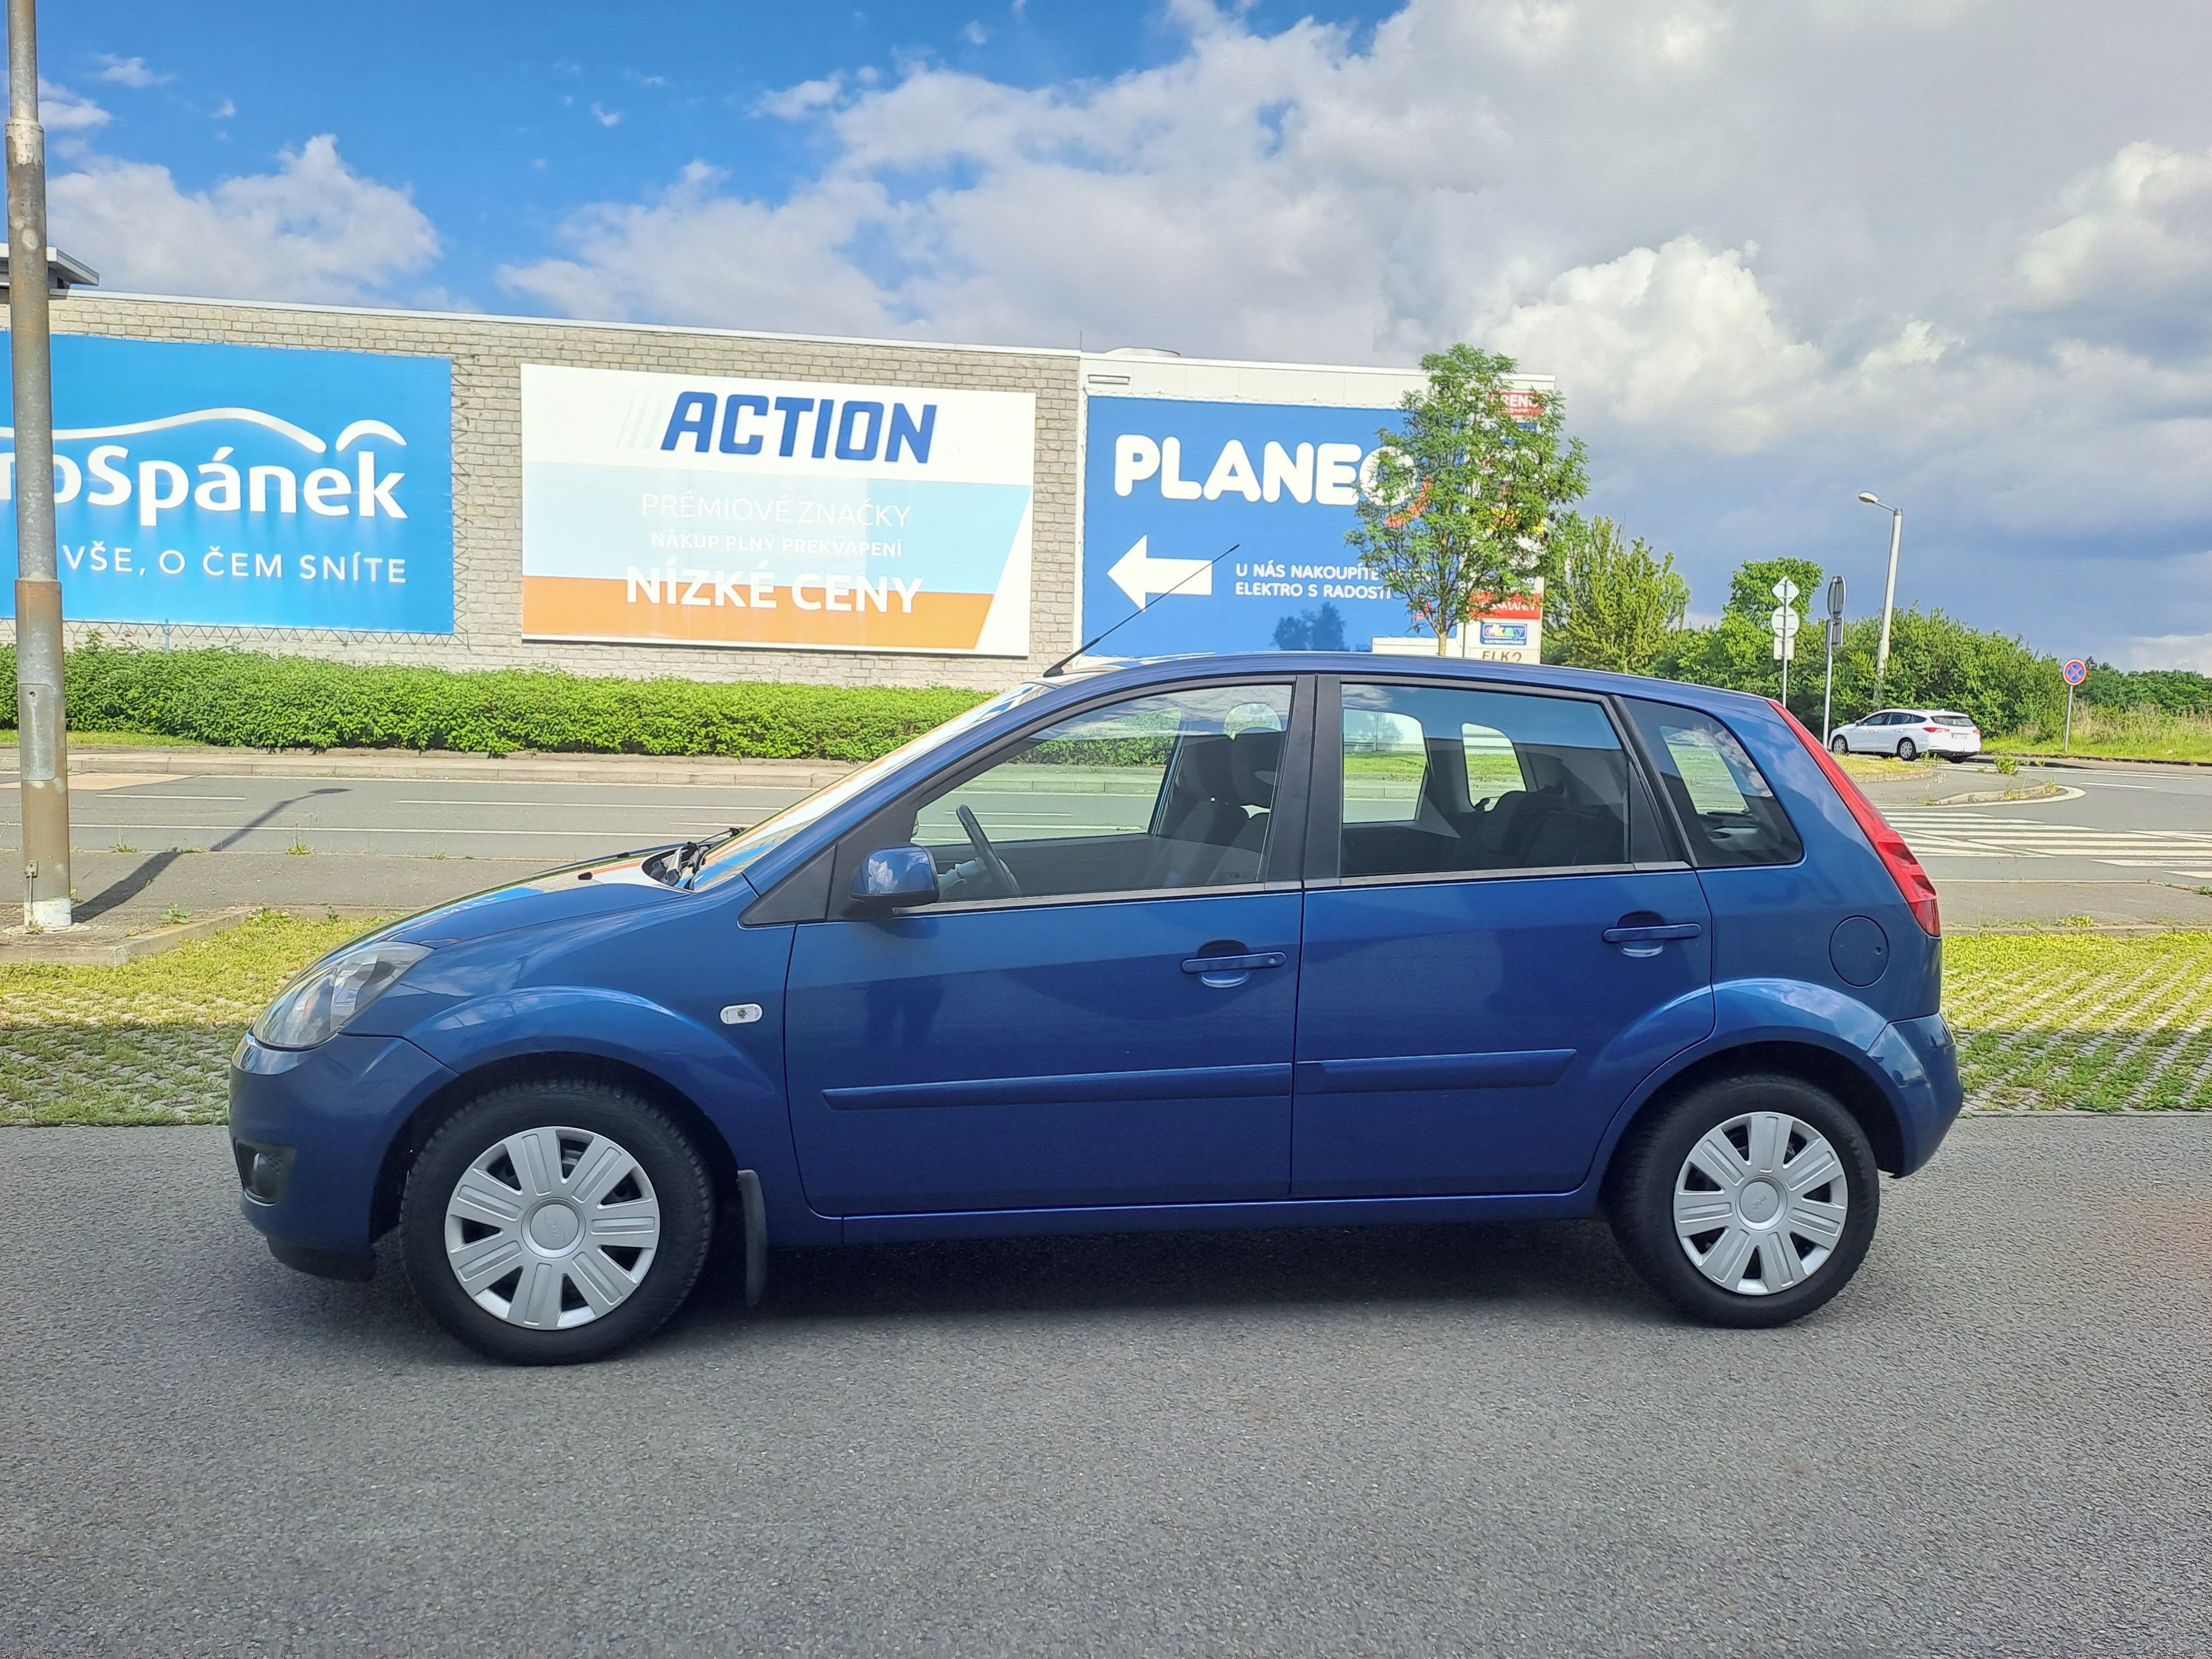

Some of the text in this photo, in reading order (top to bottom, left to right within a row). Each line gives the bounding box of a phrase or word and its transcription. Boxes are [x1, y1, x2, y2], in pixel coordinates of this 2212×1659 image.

[660, 391, 937, 463] ACTION
[1115, 434, 1417, 507] PLANEO
[642, 489, 912, 527] PRÉMIOVÉ ZNAČKY
[62, 540, 408, 584] VŠE, O ČEM SNÍTE
[651, 529, 903, 557] NÁKUP PLNÝ PŘEKVAPENÍ
[627, 555, 925, 614] NÍZKÉ CENY
[1235, 563, 1248, 577] U
[1253, 560, 1286, 578] NÁS
[1291, 562, 1380, 582] NAKOUPÍTE
[1235, 582, 1303, 597] ELEKTRO
[1308, 583, 1318, 598] S
